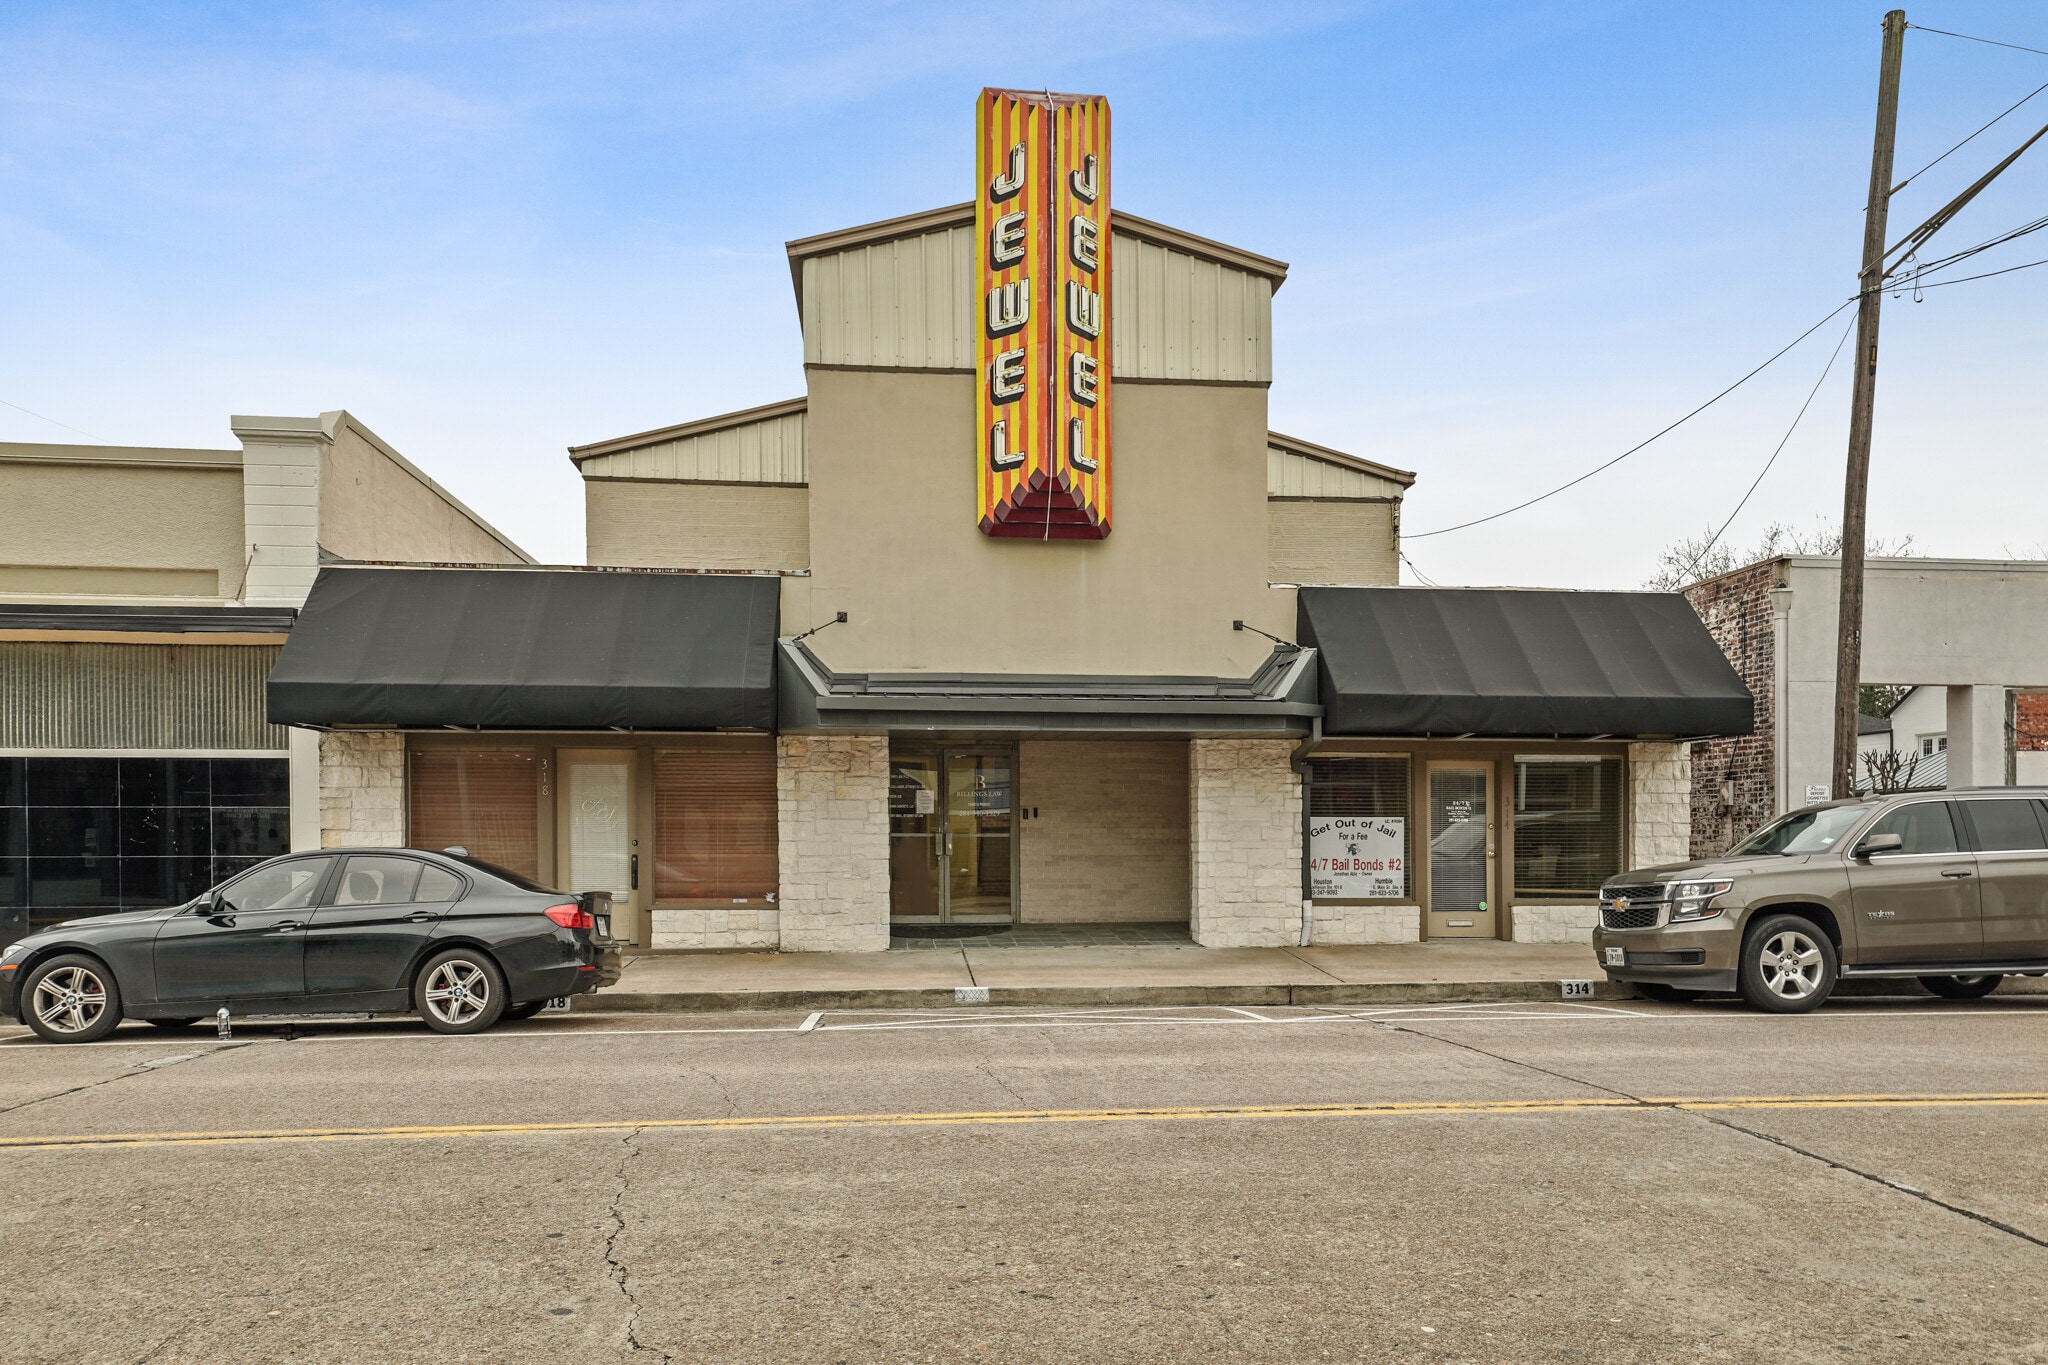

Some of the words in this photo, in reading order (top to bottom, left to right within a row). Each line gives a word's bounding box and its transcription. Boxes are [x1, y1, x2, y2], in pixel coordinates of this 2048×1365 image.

[988, 141, 1030, 472] JEWEL
[1067, 154, 1102, 473] JEWEL
[541, 758, 549, 796] 318
[1310, 823, 1331, 838] Get
[1335, 818, 1356, 829] Out
[1360, 820, 1374, 829] of
[1377, 824, 1397, 838] Jail
[1338, 832, 1349, 841] For
[1356, 832, 1368, 840] Fee
[1310, 857, 1329, 872] 4/7
[1331, 858, 1350, 871] Bail
[1353, 858, 1384, 871] Bonds
[1388, 858, 1402, 871] #2
[1374, 877, 1393, 885] Humble
[1566, 983, 1590, 995] 314
[549, 997, 567, 1009] 18
